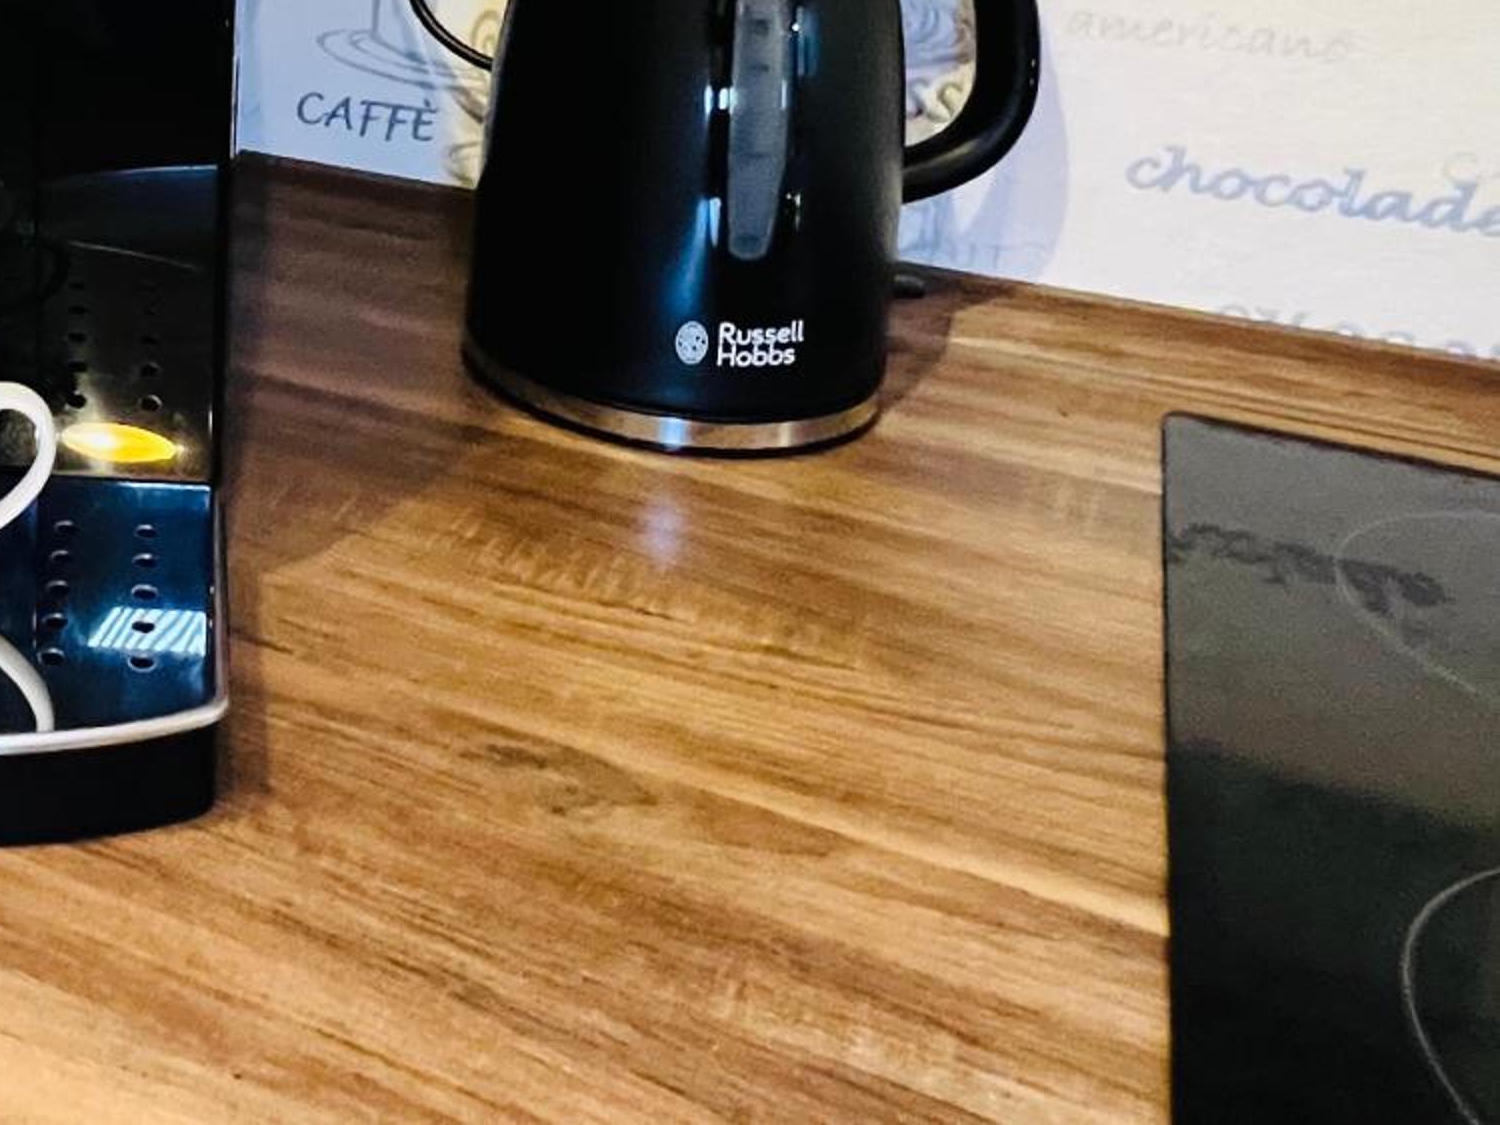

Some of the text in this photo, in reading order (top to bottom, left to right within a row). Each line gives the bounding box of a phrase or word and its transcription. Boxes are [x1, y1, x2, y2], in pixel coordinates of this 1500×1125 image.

[296, 91, 437, 143] CAFFÈ
[1124, 144, 1500, 238] chocolade
[718, 320, 804, 345] Russell
[716, 342, 796, 367] Hobbs
